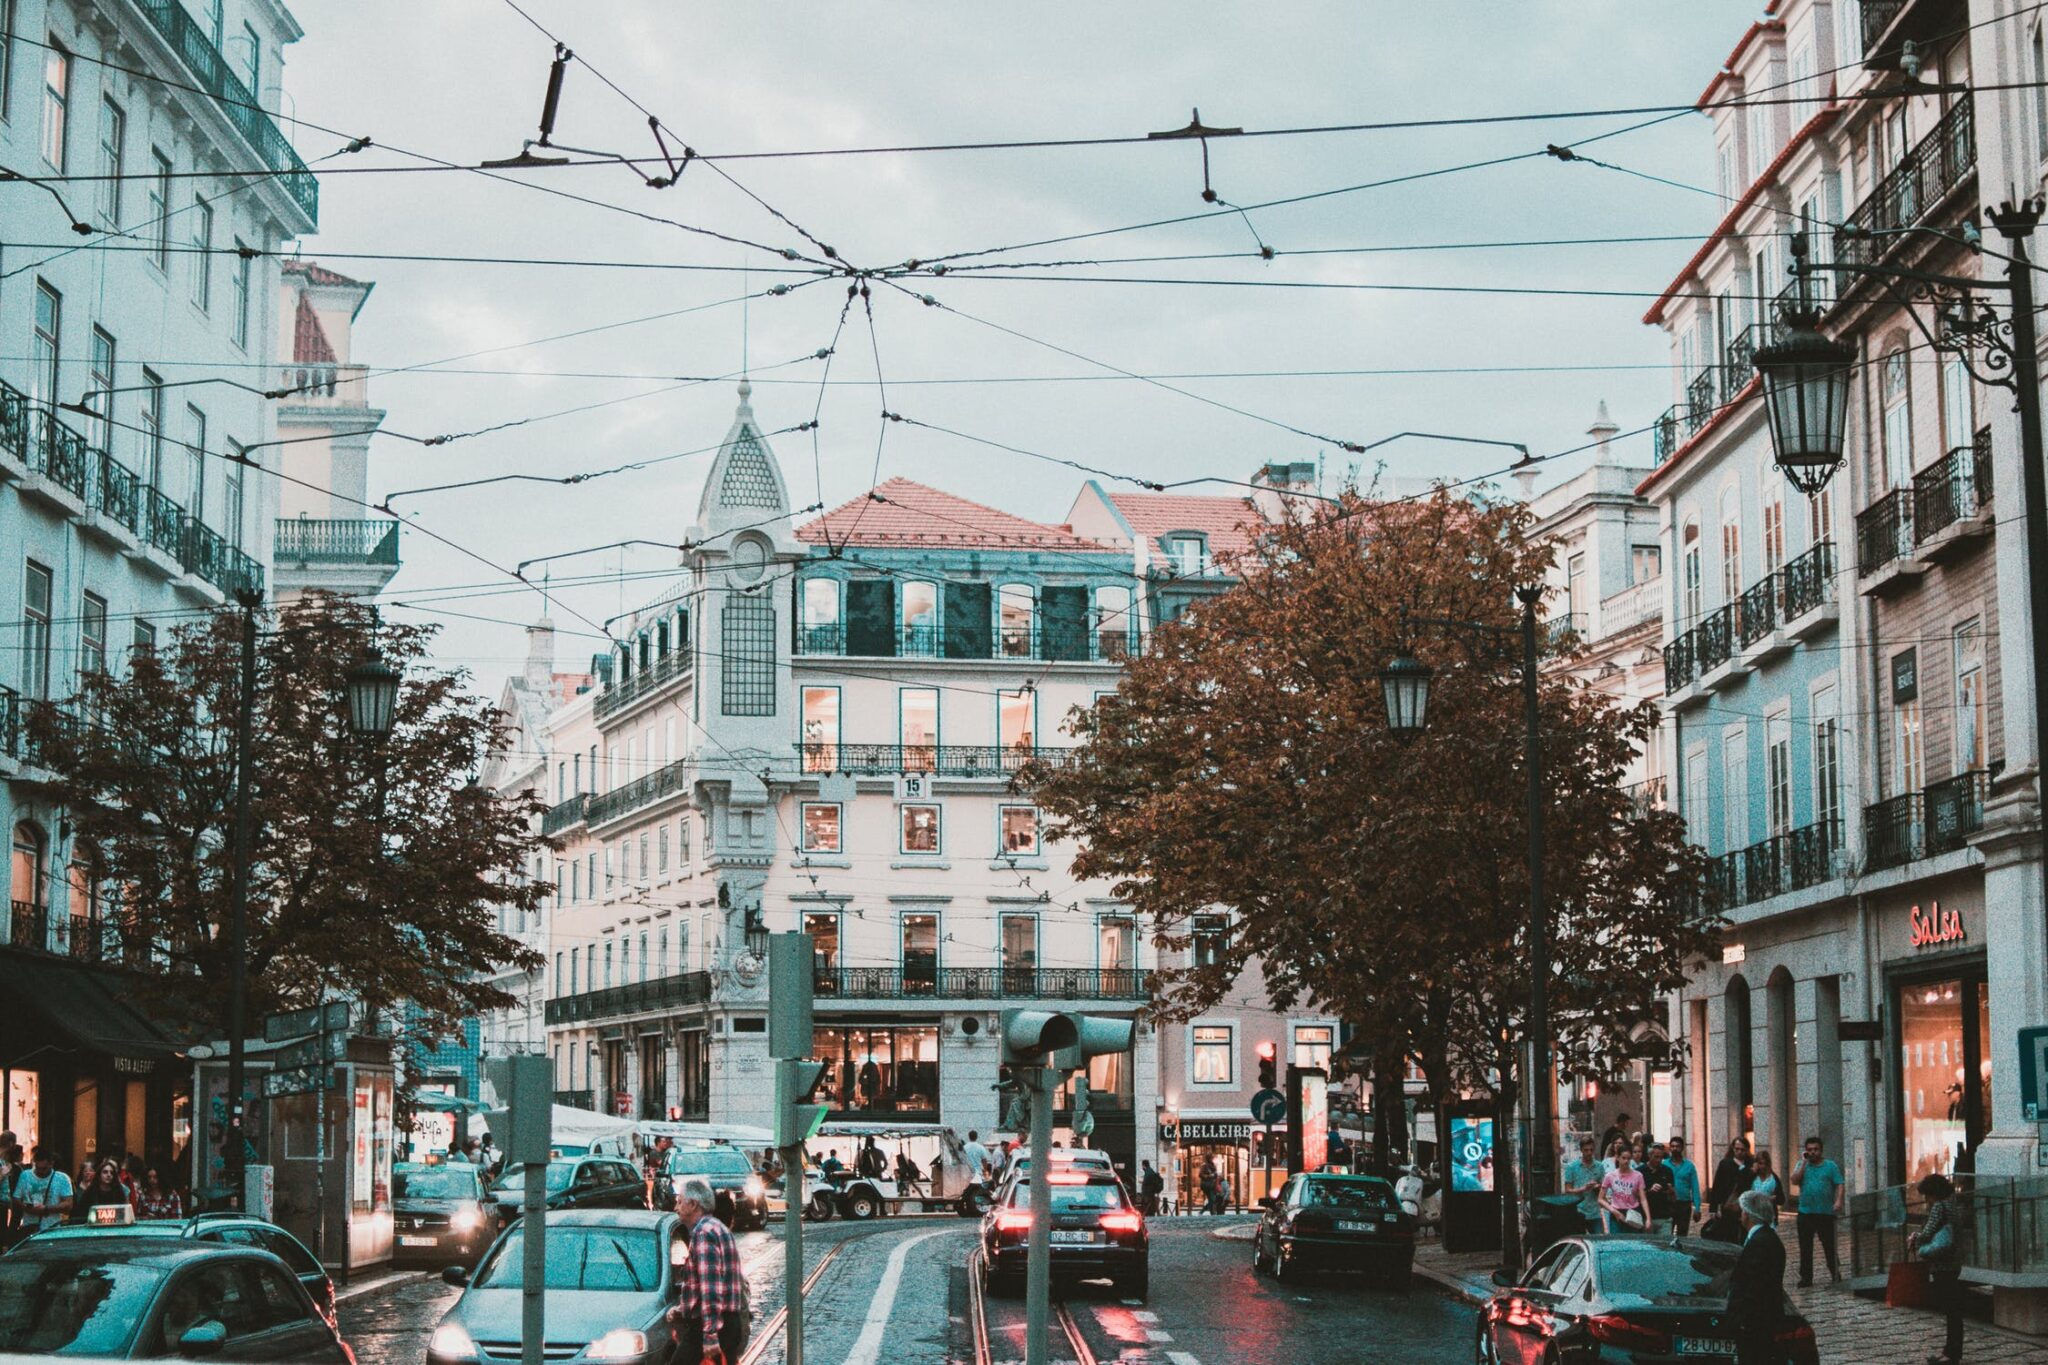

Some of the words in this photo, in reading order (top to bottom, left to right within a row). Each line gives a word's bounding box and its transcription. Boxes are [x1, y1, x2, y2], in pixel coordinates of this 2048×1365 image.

[905, 779, 920, 792] 15
[1909, 901, 1964, 946] Salsa
[97, 1208, 116, 1220] TAXI
